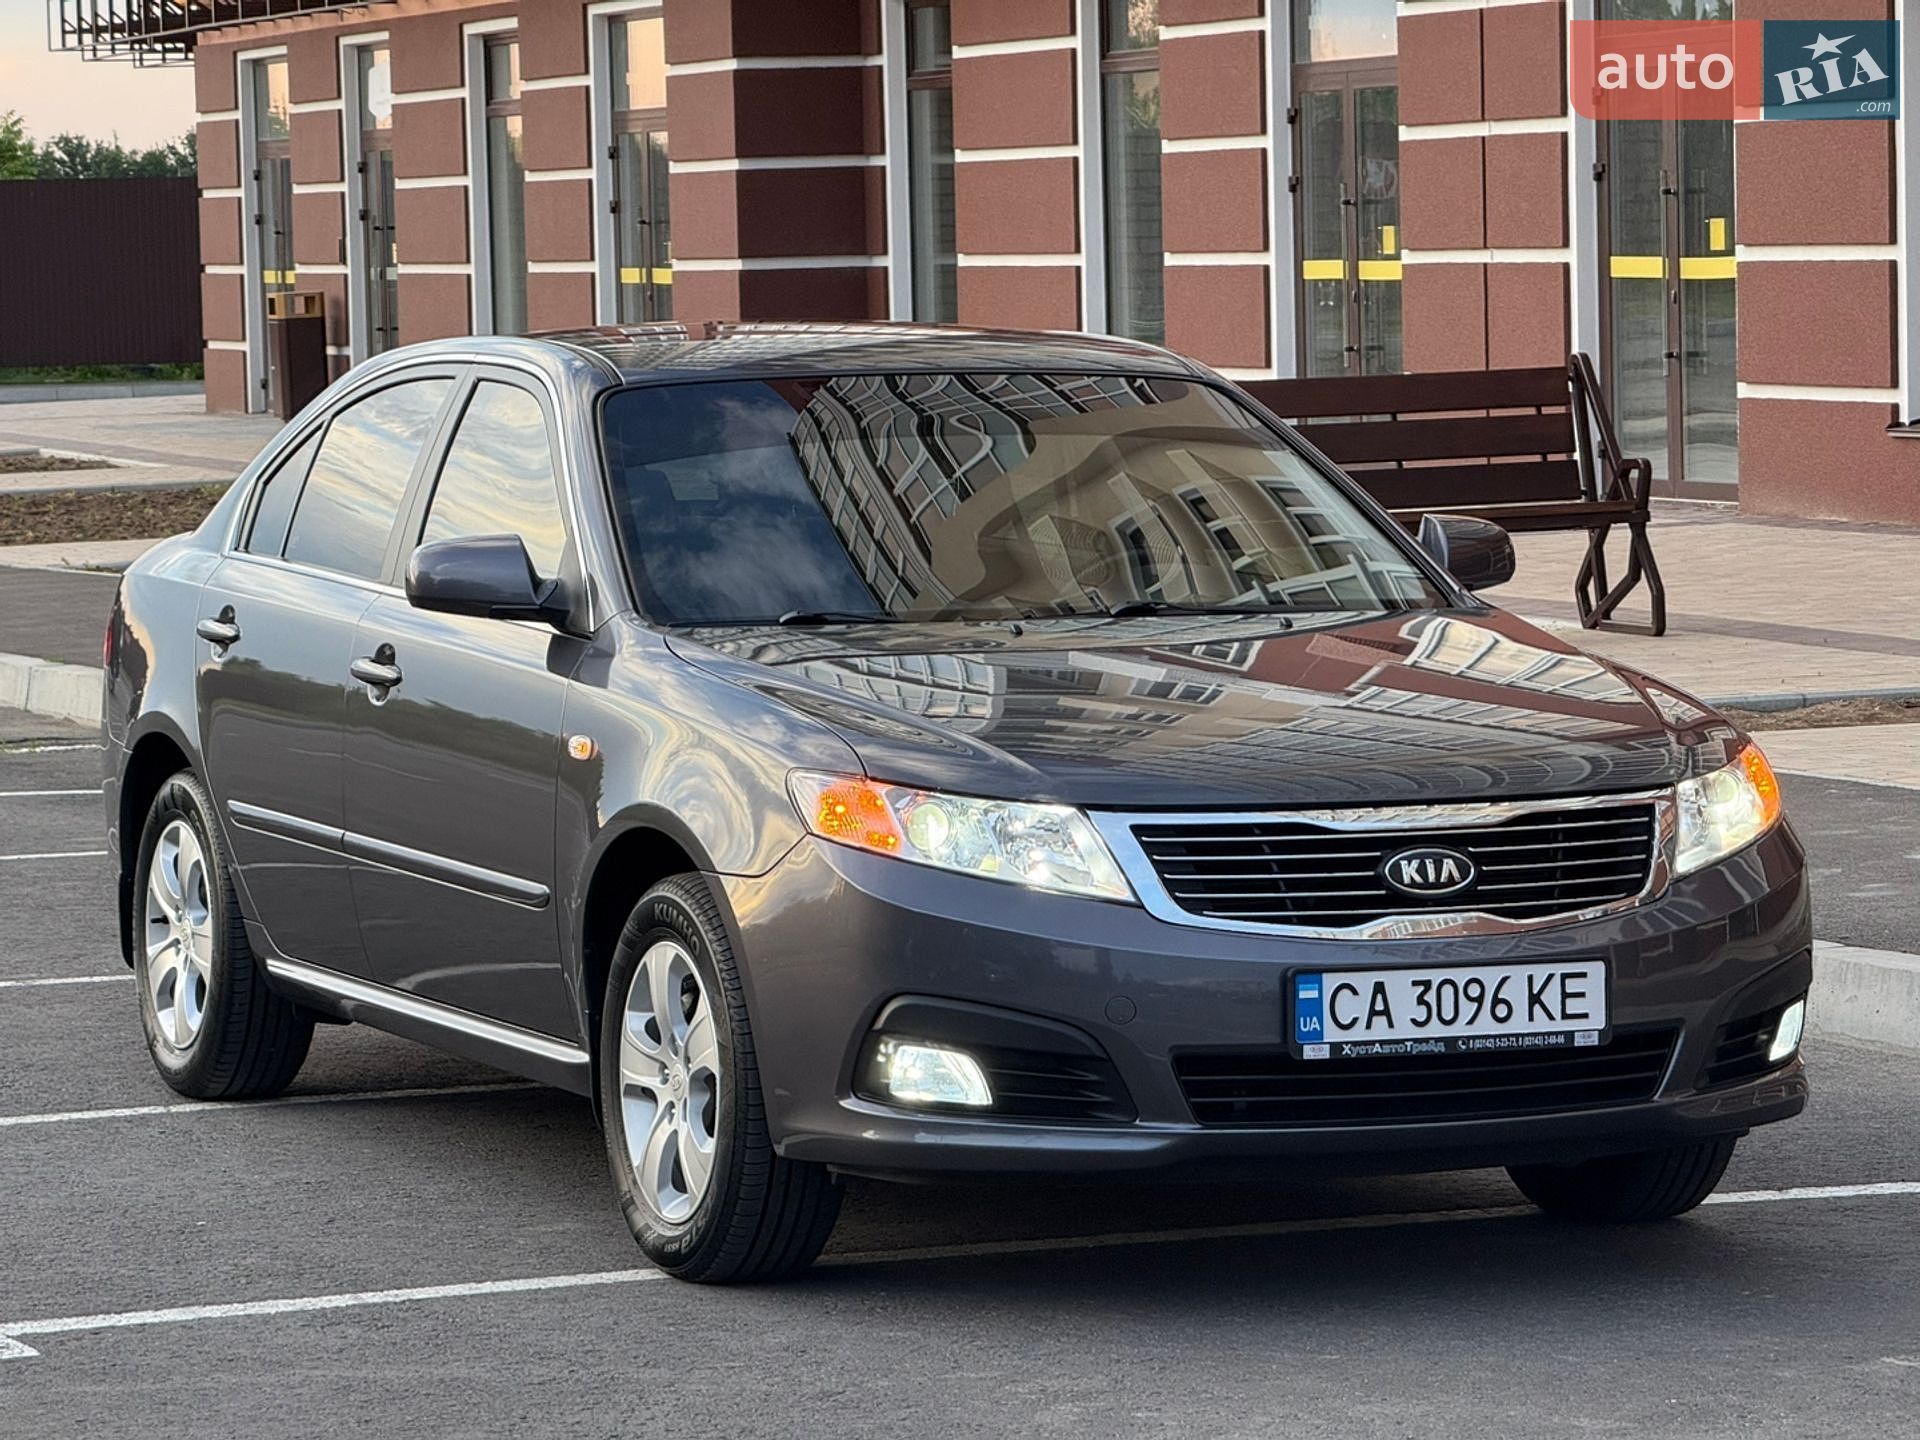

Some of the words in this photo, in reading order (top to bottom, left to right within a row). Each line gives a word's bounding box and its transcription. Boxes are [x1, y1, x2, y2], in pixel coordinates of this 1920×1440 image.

[1399, 858, 1462, 884] KIA
[653, 902, 701, 956] KUMHO
[1329, 980, 1394, 1031] CA
[1410, 975, 1513, 1029] 3096
[1527, 971, 1591, 1023] KE
[1300, 1016, 1321, 1032] UA
